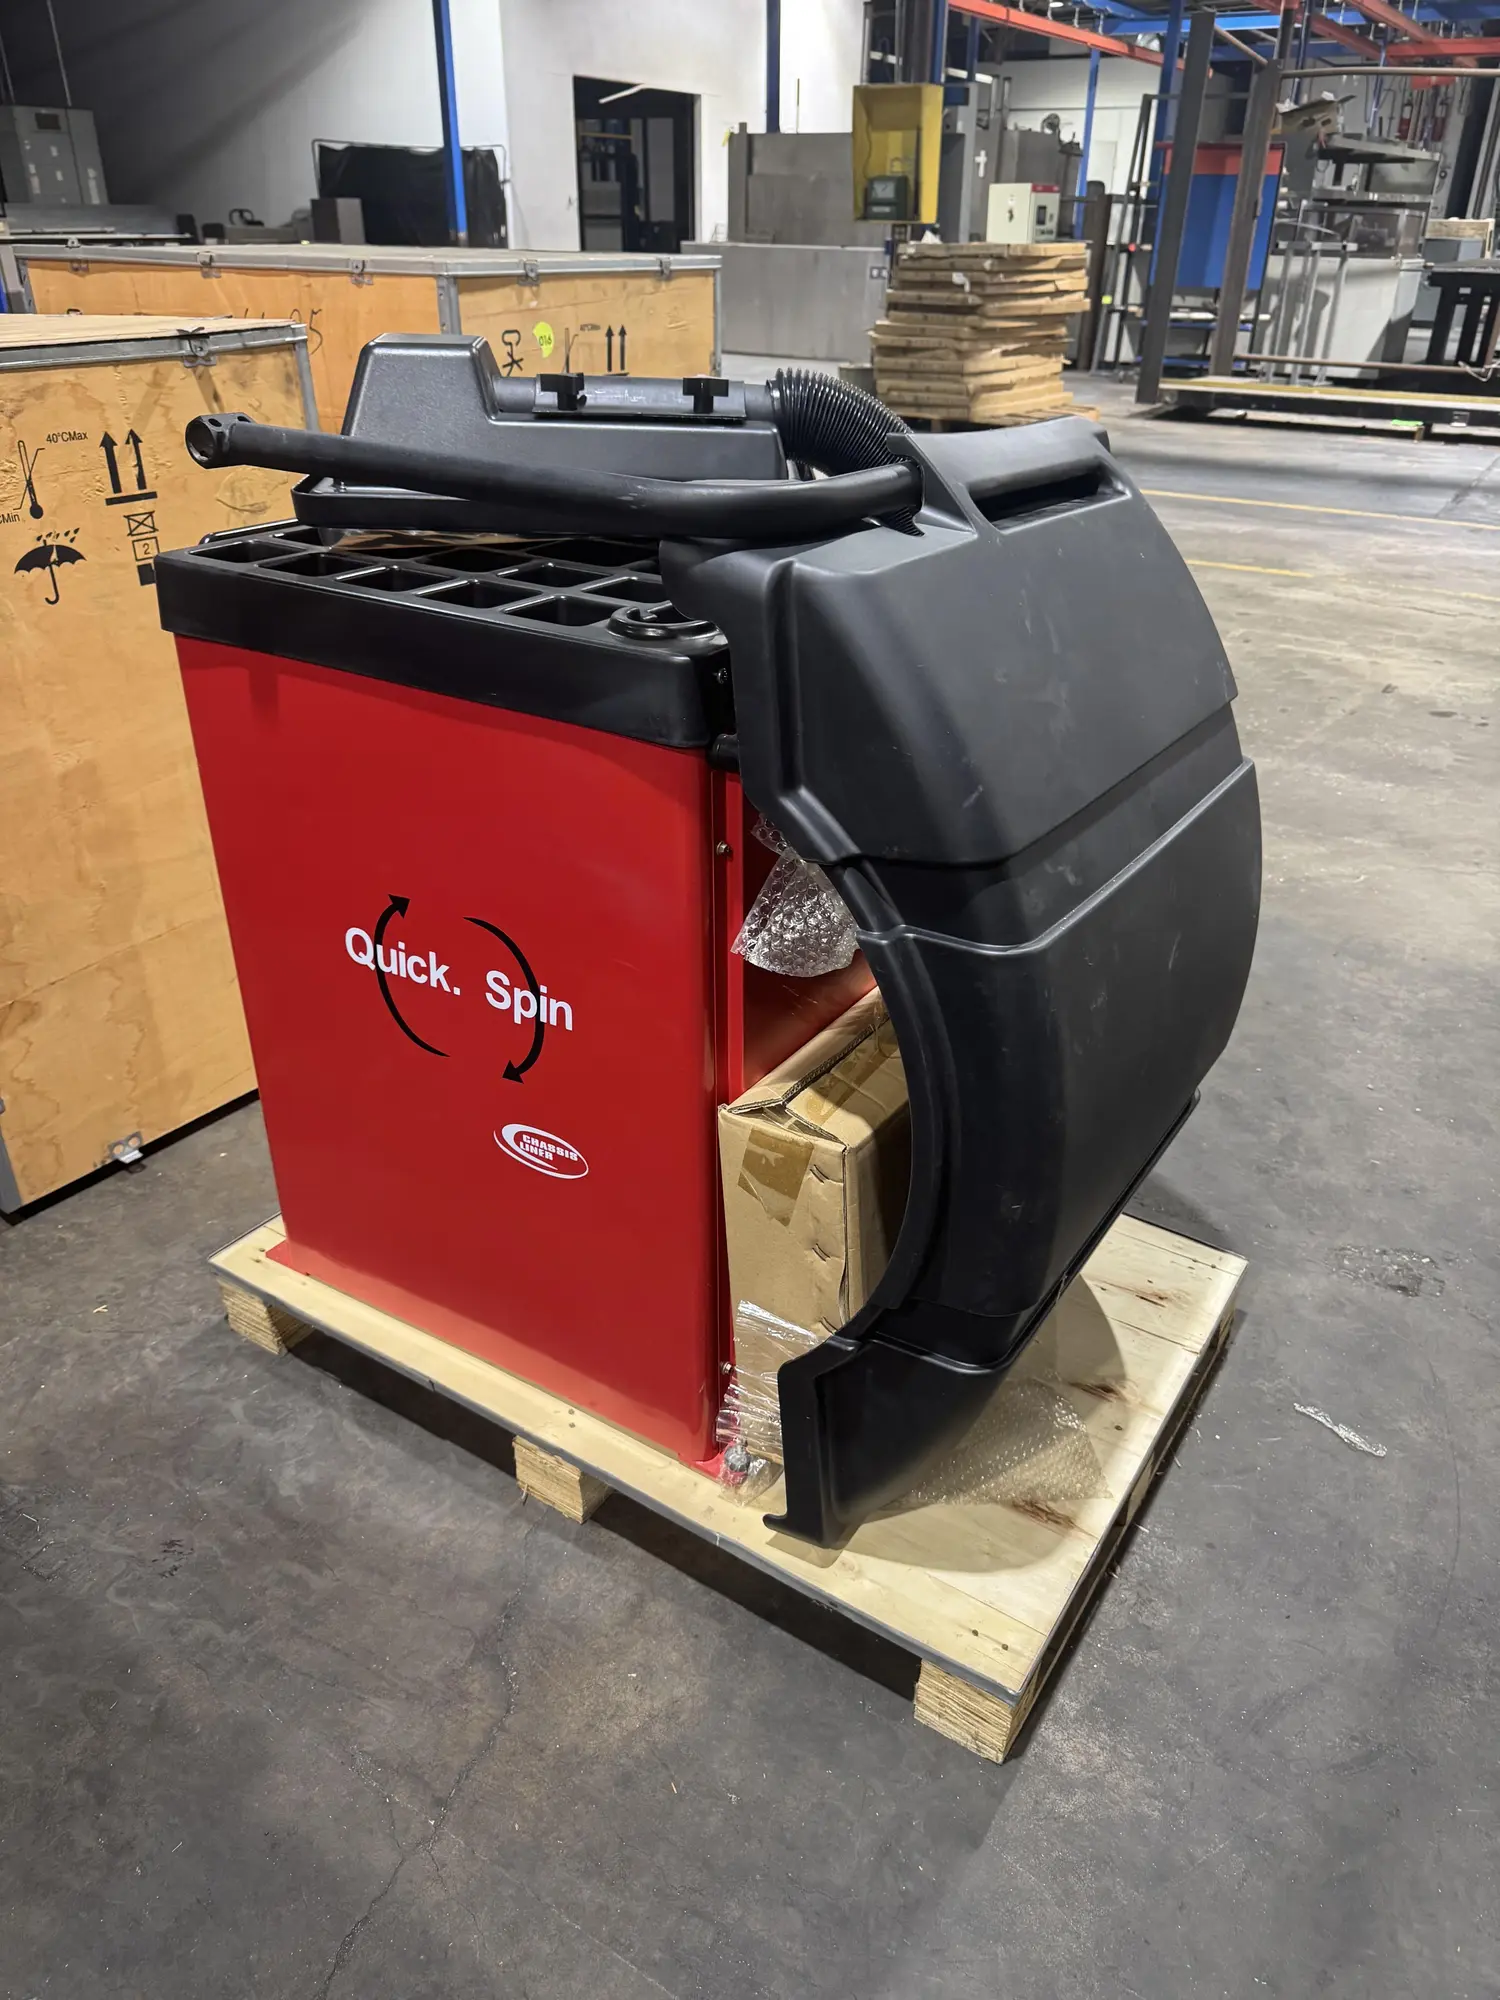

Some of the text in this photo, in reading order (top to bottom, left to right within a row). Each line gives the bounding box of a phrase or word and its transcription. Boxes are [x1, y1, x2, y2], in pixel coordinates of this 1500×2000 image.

[0, 512, 20, 524] Min
[142, 542, 151, 555] 2
[345, 926, 573, 1031] Quick. Spin
[519, 1141, 553, 1161] LINER
[522, 1134, 579, 1161] CHASSIS
